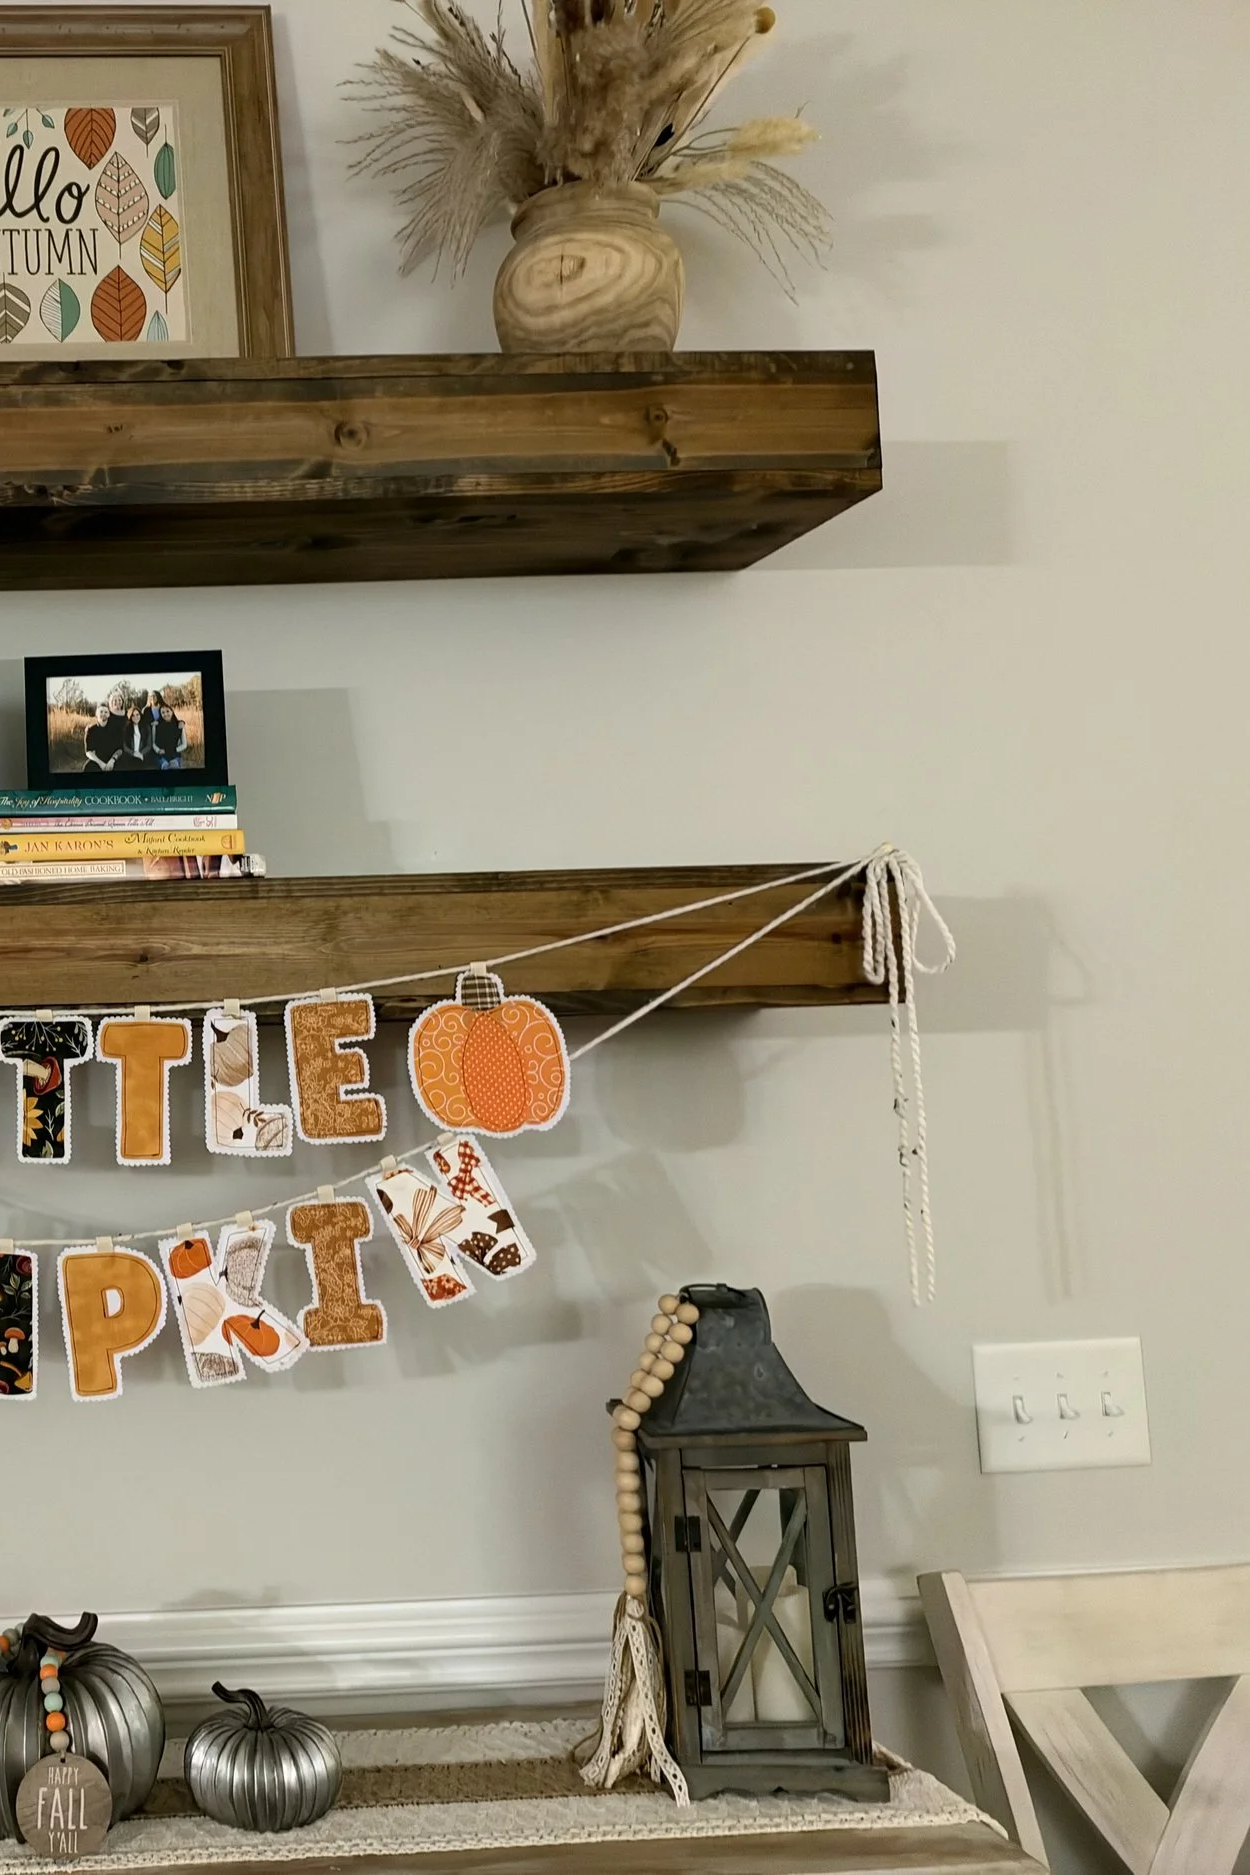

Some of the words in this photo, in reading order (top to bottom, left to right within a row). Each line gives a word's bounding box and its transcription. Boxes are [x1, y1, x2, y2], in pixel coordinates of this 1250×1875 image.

[30, 796, 41, 808] of
[84, 795, 142, 805] COOKBOOK
[124, 832, 165, 844] Mitford
[167, 833, 206, 843] Cookbook
[25, 841, 49, 853] JAN
[55, 839, 114, 852] KARON'S
[64, 865, 88, 874] HOME
[90, 863, 121, 873] BAKING
[48, 1767, 78, 1785] HAPPY
[37, 1787, 88, 1830] FALL
[48, 1831, 78, 1854] Y'ALL
